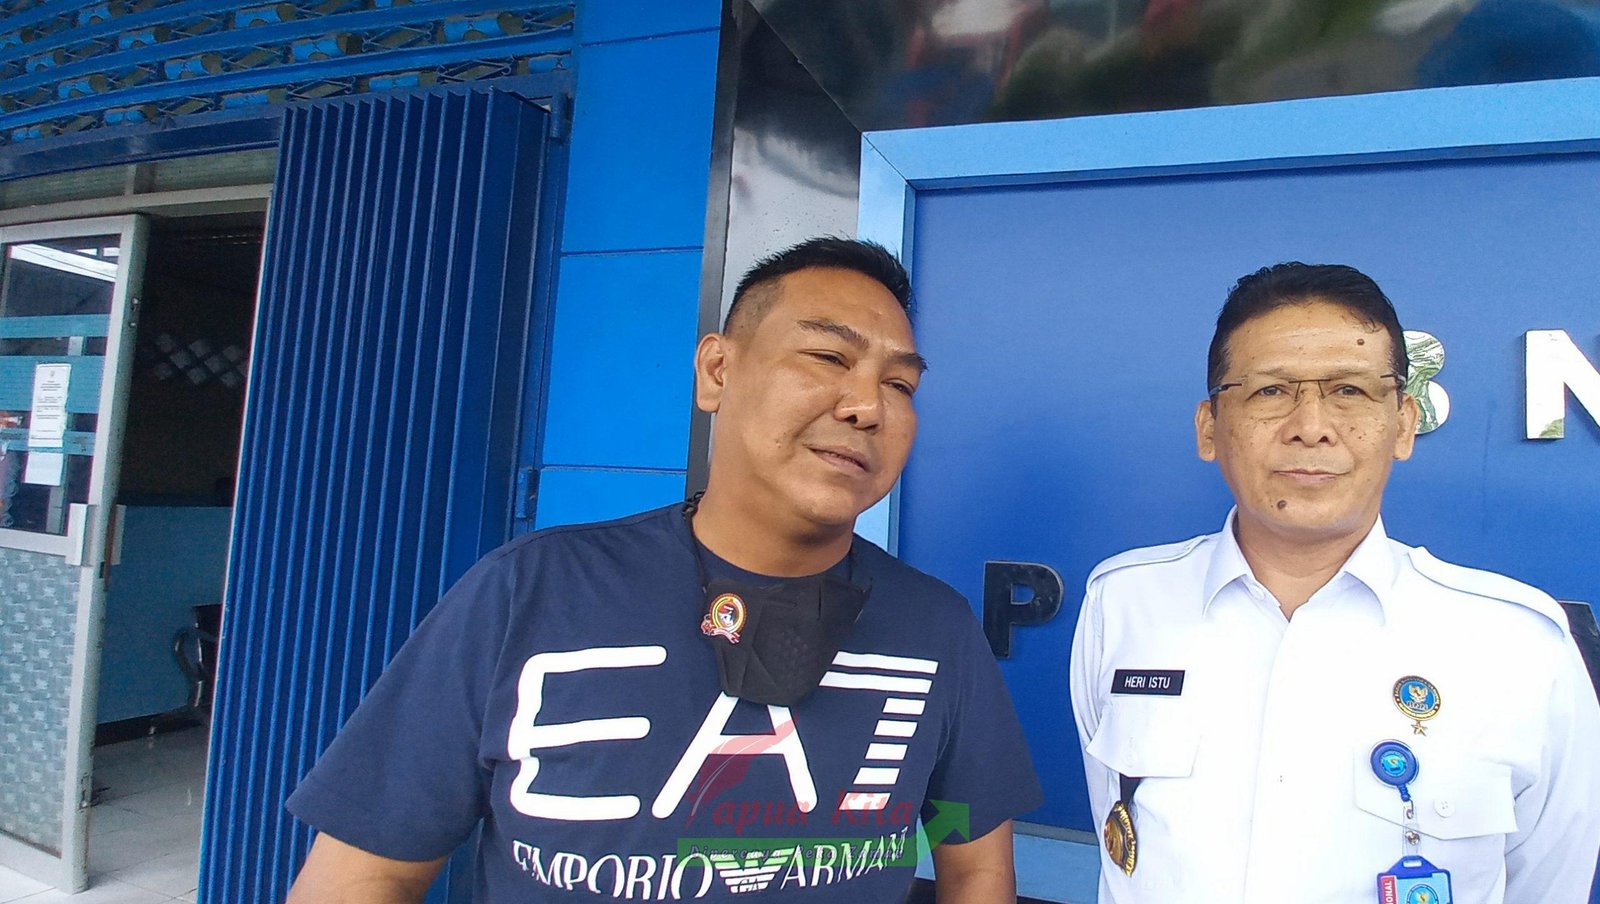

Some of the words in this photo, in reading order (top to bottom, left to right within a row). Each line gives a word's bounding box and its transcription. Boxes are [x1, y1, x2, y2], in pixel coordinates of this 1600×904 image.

[1124, 675, 1146, 688] HERI
[1148, 676, 1171, 689] ISTU
[507, 645, 939, 821] EA7
[512, 839, 714, 900] EMPORIO
